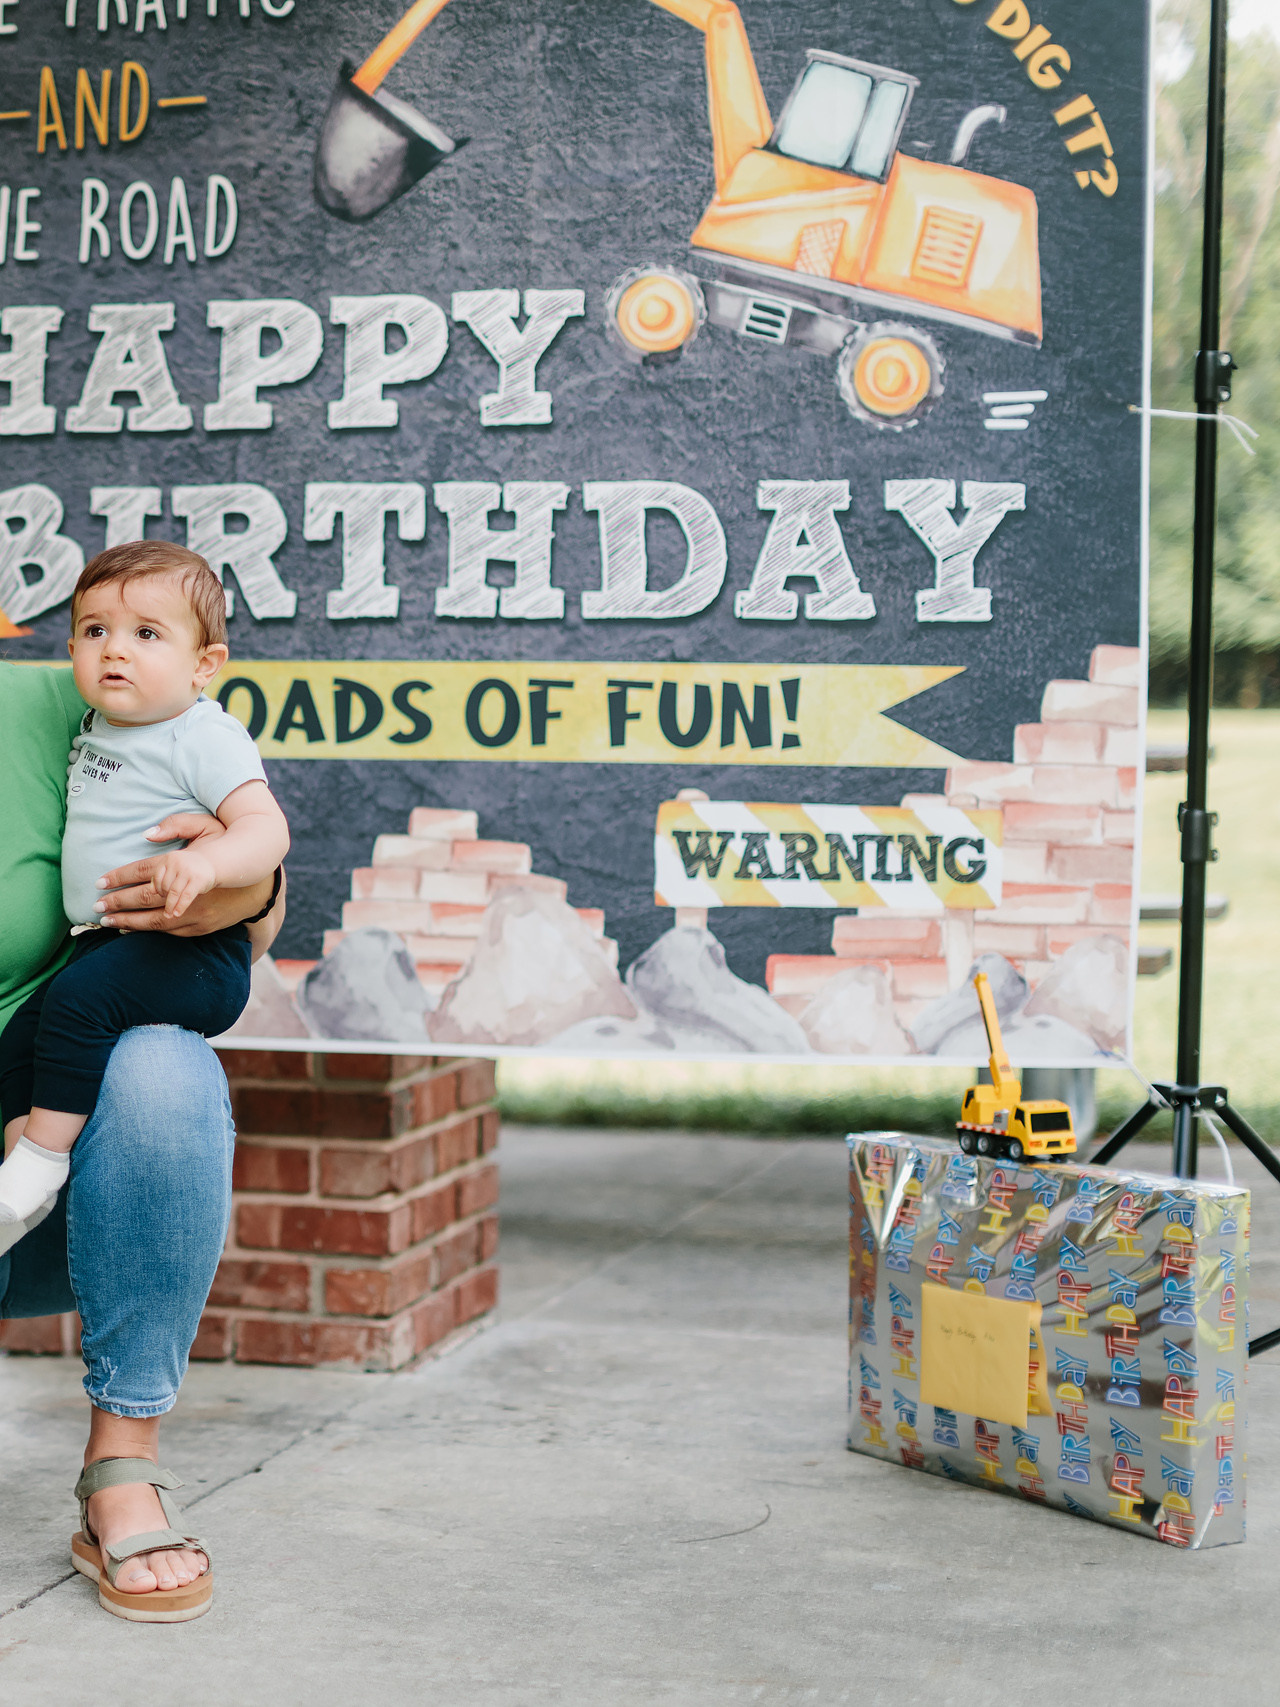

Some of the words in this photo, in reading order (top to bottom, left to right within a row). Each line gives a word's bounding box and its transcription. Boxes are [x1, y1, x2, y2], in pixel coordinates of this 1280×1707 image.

[985, 0, 1071, 90] DIG
[1053, 94, 1119, 198] IT?
[78, 174, 239, 265] ROAD
[465, 678, 575, 747] OF
[606, 677, 802, 750] FUN!
[97, 756, 123, 772] BUNNY
[99, 771, 110, 782] ME
[669, 830, 989, 884] WARNING
[889, 1282, 917, 1381] HAPPY
[1054, 1235, 1092, 1338] HAPPY
[1160, 1337, 1199, 1446] HAPPY
[974, 1417, 1005, 1485] HAP
[1108, 1416, 1145, 1524] HAPPY
